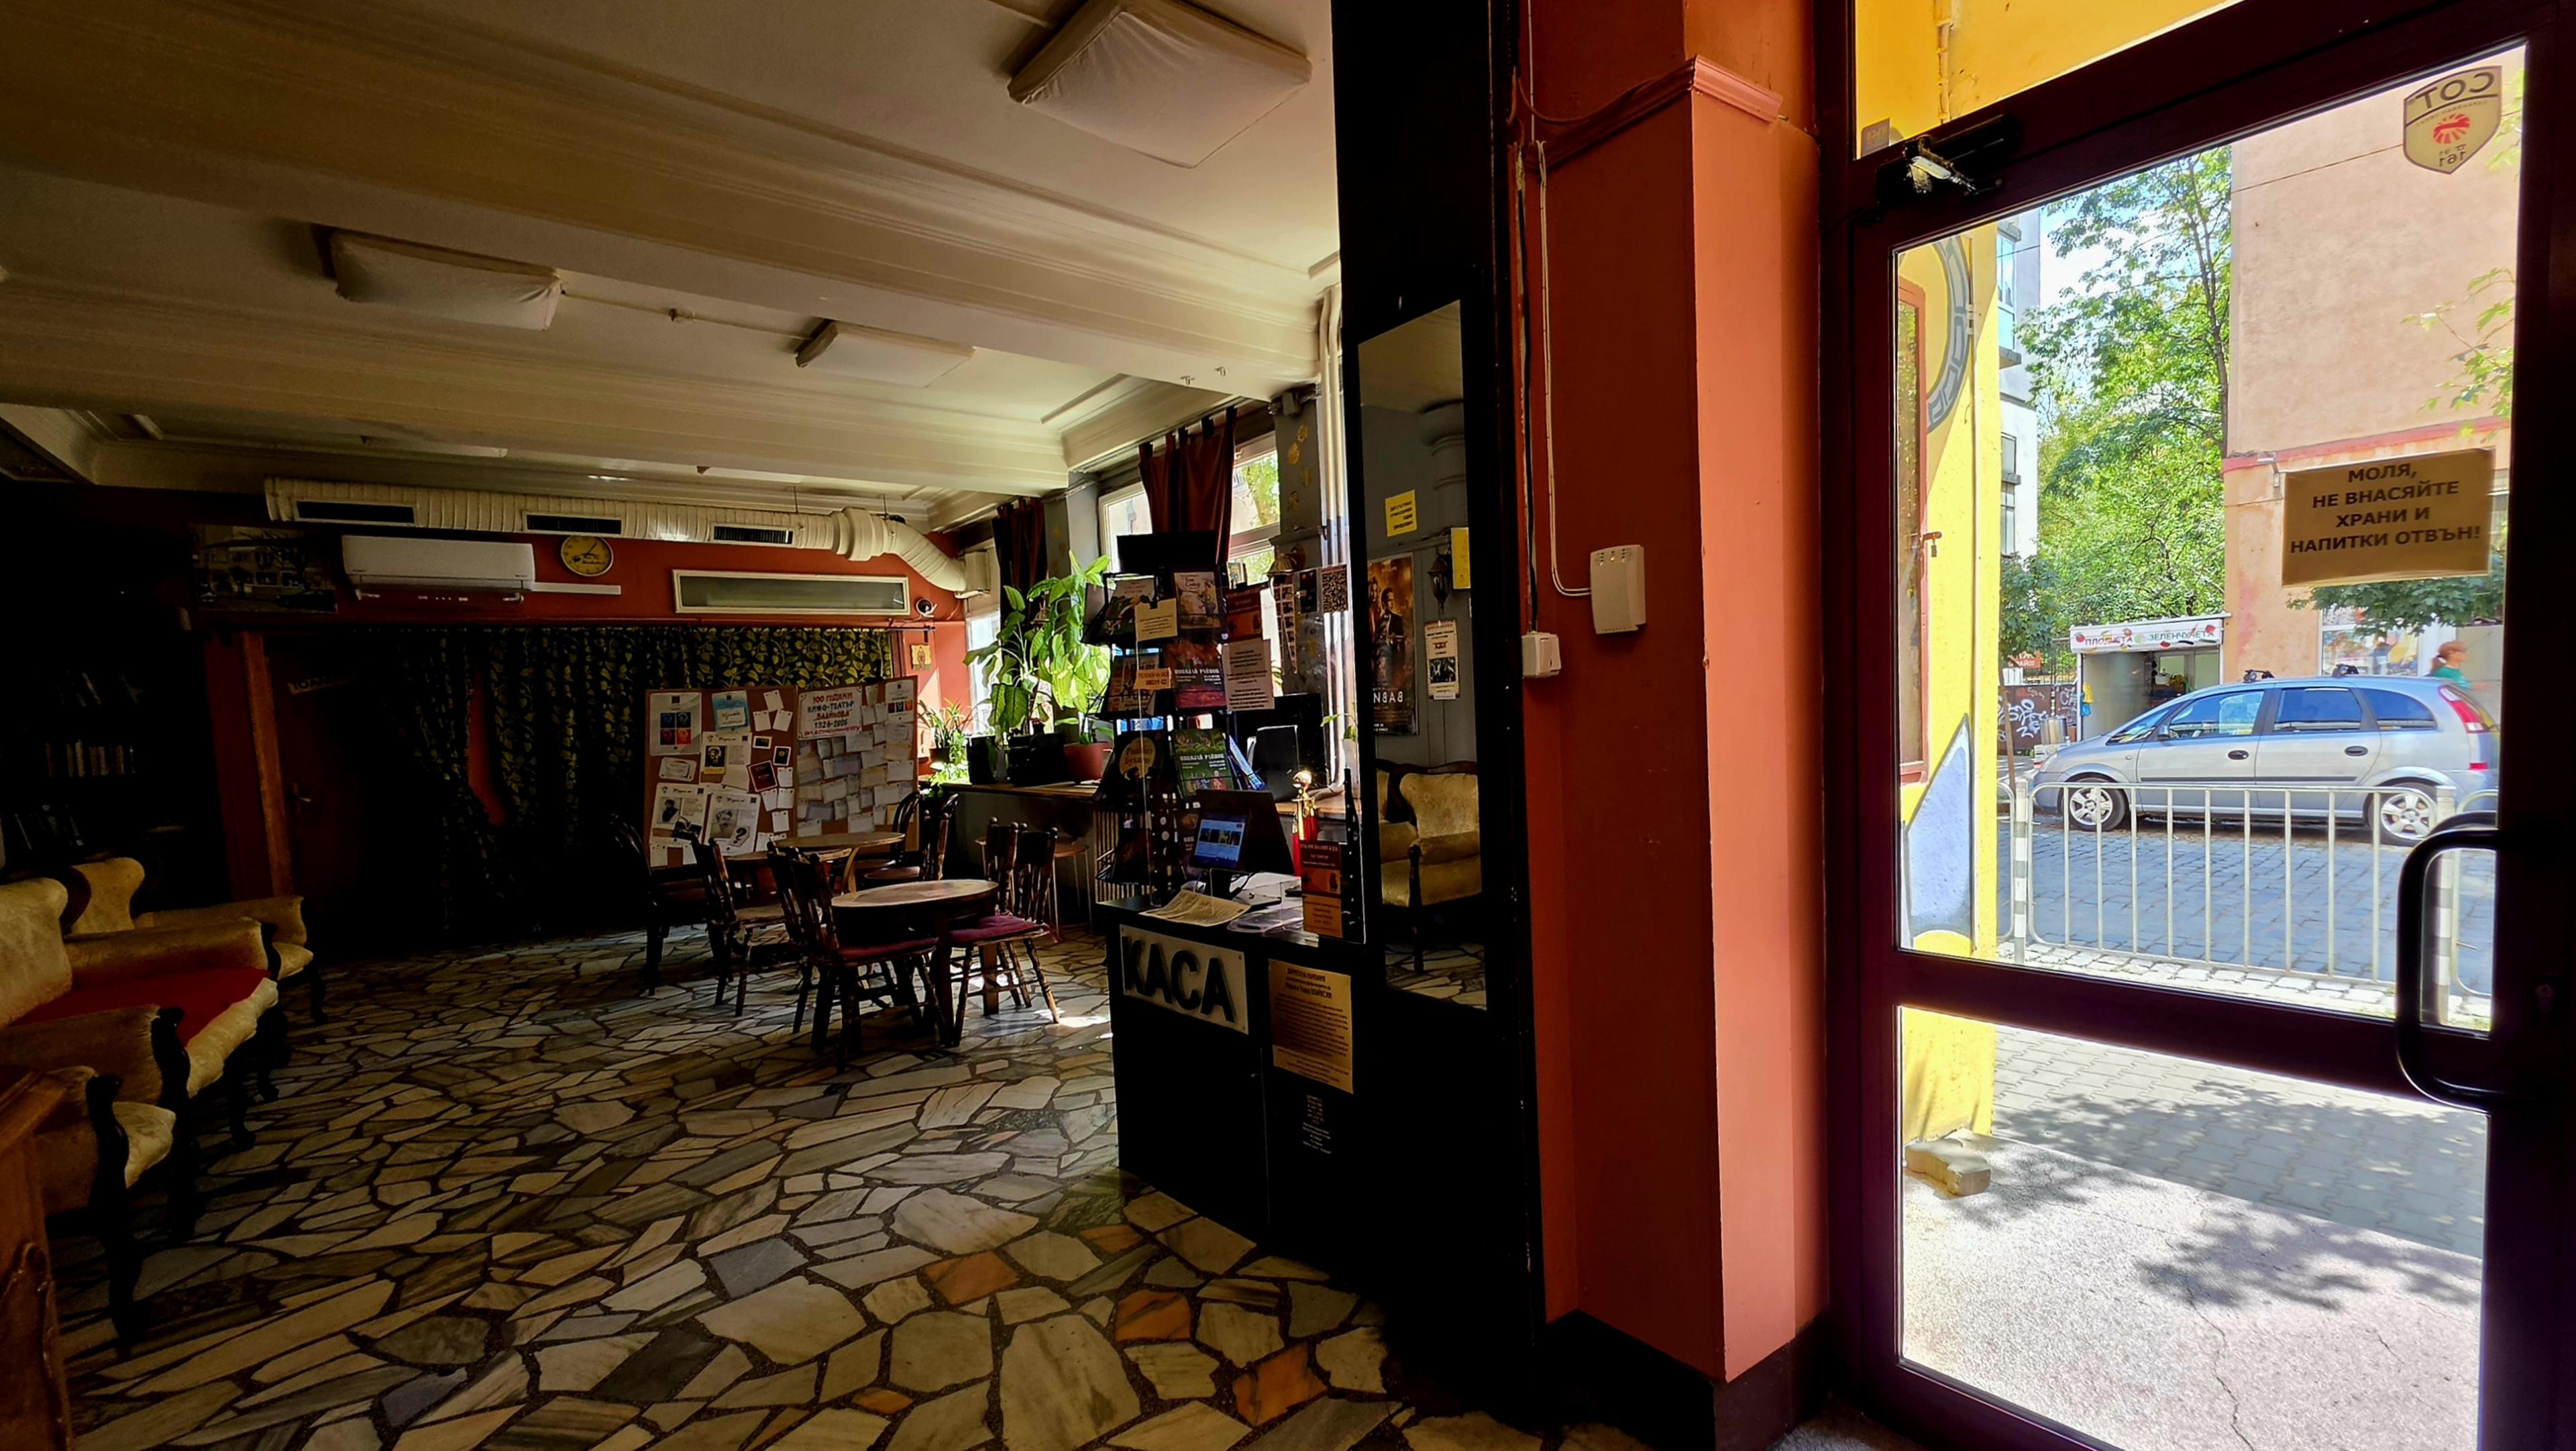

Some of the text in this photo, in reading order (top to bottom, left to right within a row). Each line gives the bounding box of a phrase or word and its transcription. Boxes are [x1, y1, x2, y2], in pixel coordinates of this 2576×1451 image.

[2347, 463, 2417, 483] МОЛЯ,
[2312, 480, 2460, 508] НЕ ВНАСЯЙТЕ
[2336, 506, 2430, 528] ХРАНИ И
[2290, 525, 2481, 553] НАПИТКИ ОТВЪН!
[826, 692, 853, 702] ГОДИНИ
[1124, 936, 1235, 1023] КАСА
